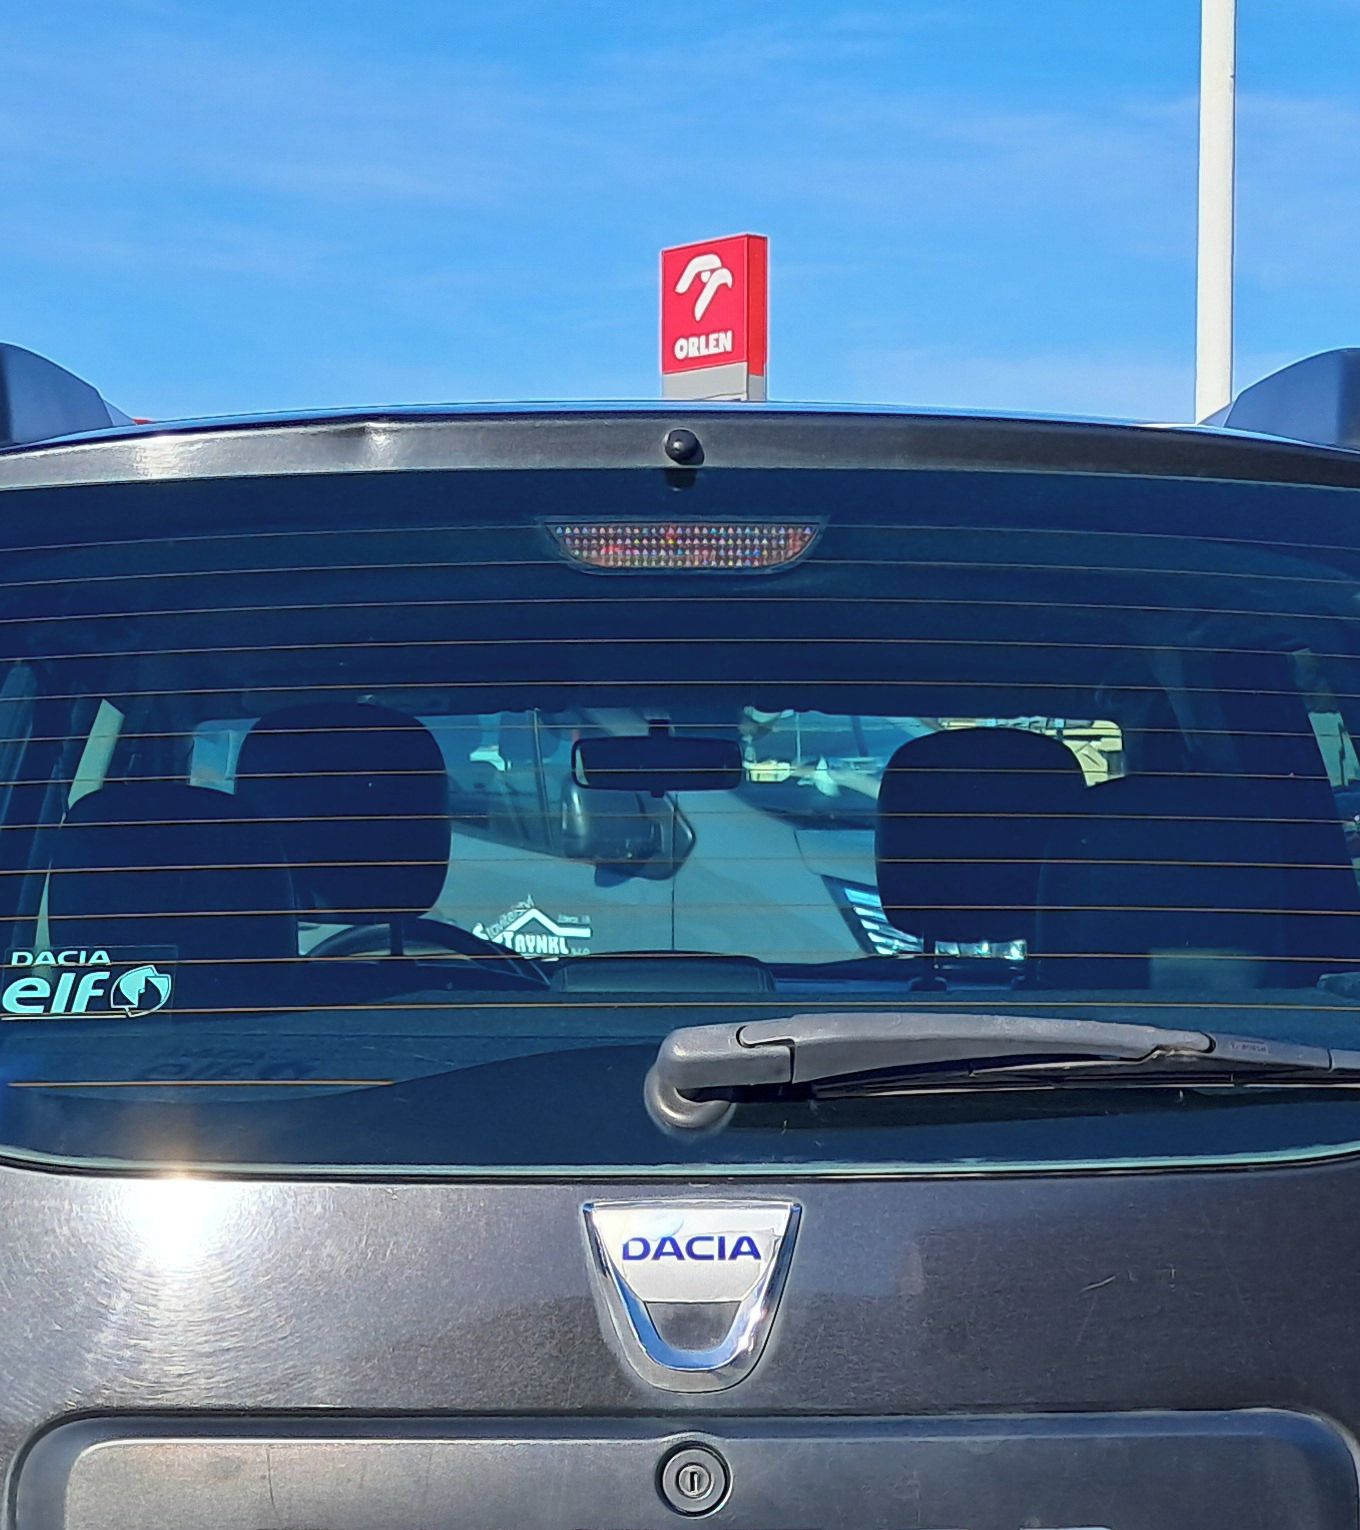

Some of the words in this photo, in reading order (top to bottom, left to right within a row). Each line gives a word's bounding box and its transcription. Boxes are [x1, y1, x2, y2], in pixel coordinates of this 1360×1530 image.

[674, 330, 733, 360] ORLEN
[11, 950, 111, 966] DACIA
[2, 971, 111, 1014] elf
[621, 1235, 762, 1261] DACIA
